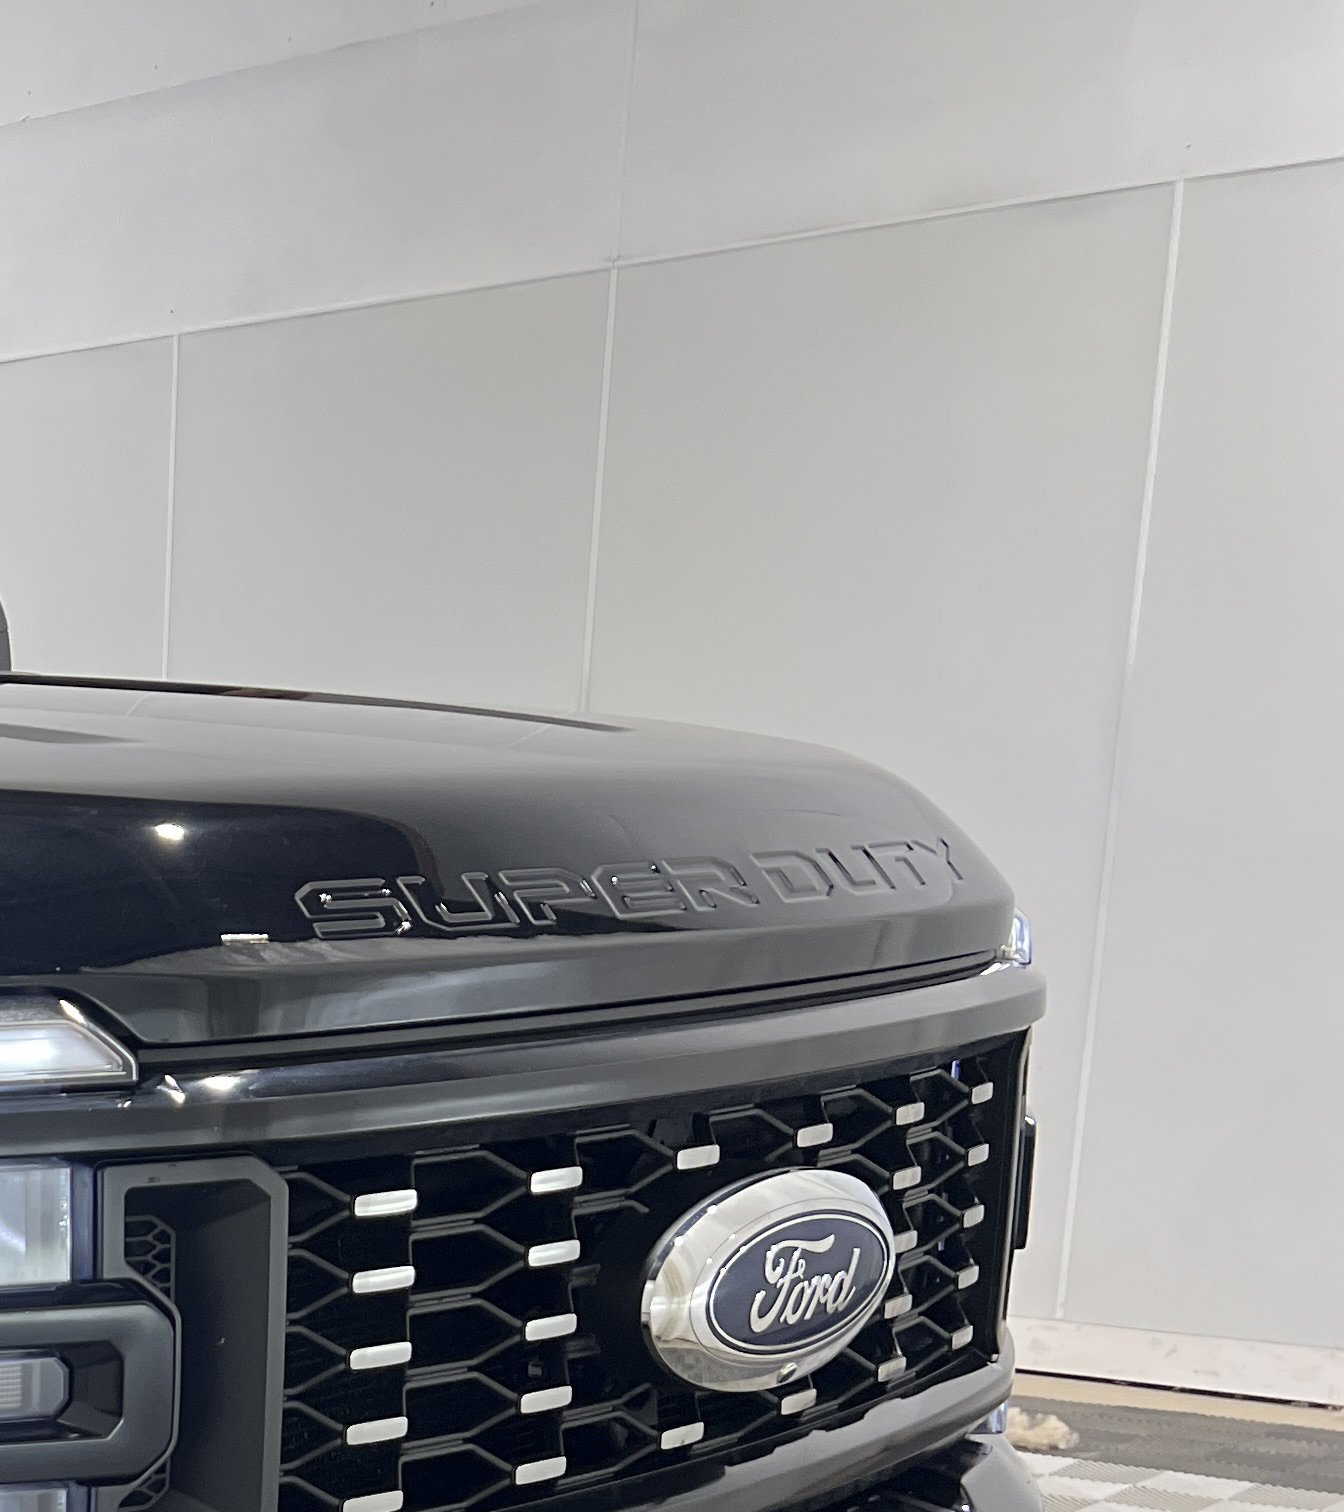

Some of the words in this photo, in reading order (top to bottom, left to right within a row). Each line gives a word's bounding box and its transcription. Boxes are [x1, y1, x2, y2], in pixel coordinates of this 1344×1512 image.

[294, 857, 759, 940] SUPER
[749, 836, 964, 904] DUTY
[749, 1233, 862, 1334] Ford
